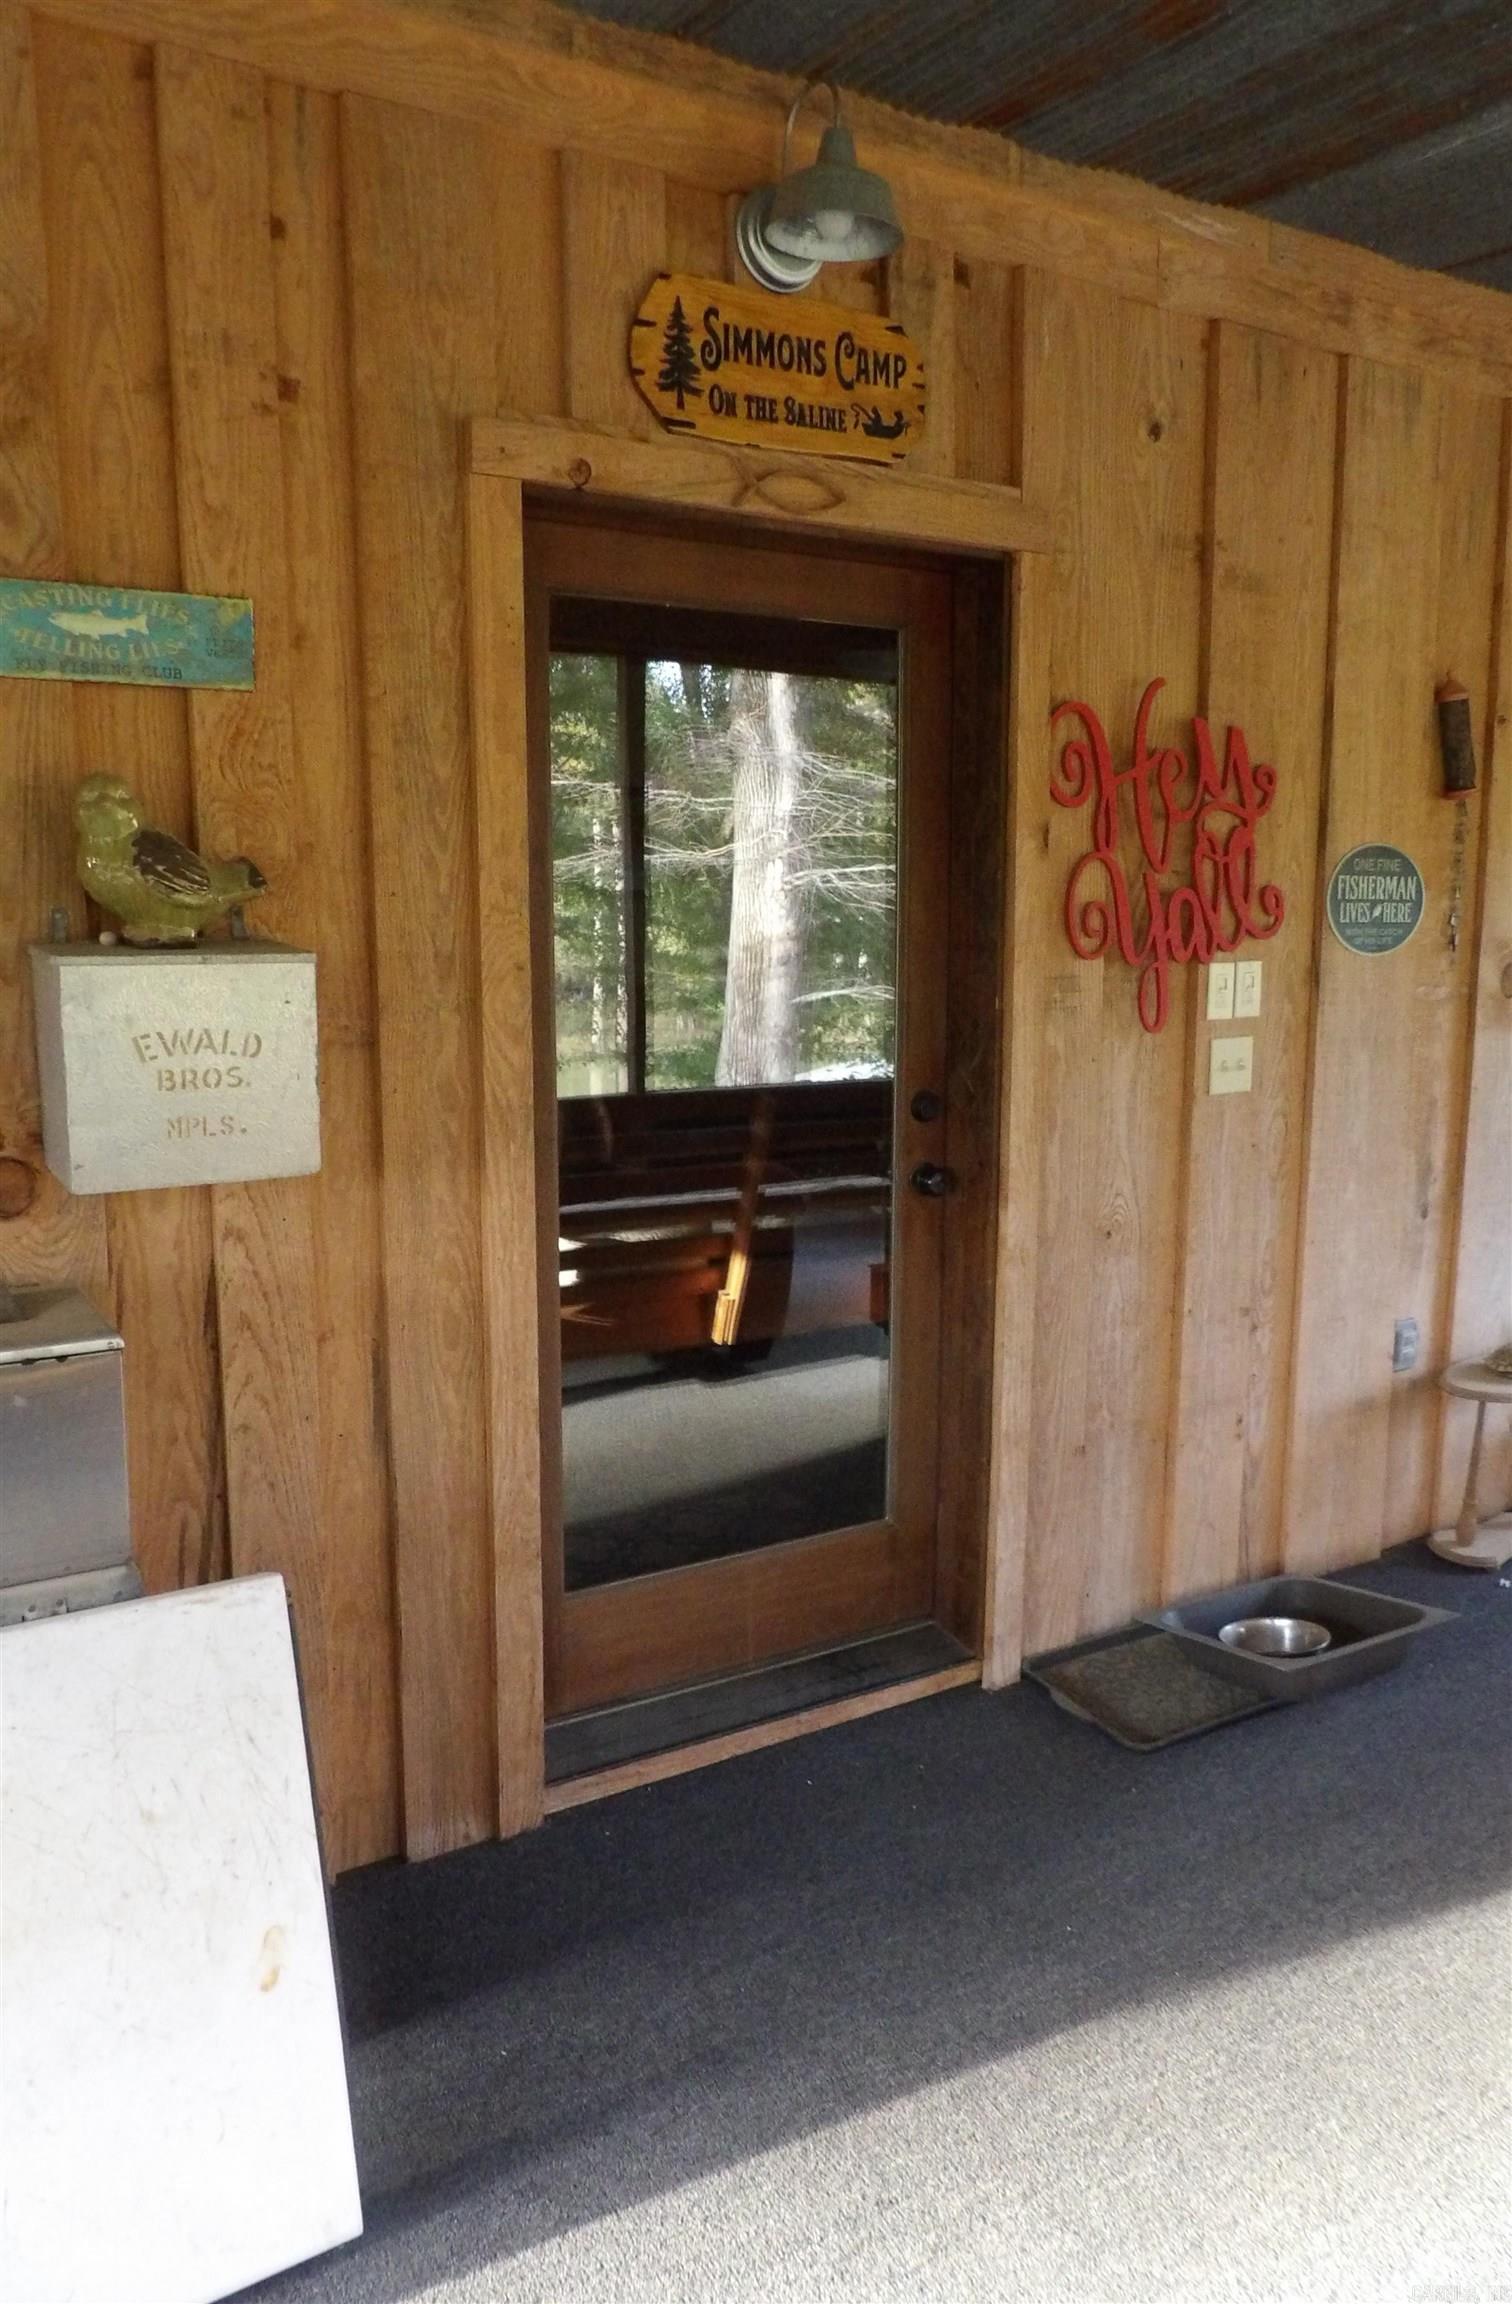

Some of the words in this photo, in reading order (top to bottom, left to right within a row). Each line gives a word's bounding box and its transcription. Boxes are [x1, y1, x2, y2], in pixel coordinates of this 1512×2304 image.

[700, 306, 828, 377] SIMMONS
[834, 331, 908, 391] CAMP
[708, 383, 737, 417] ON
[744, 392, 778, 424] THE
[783, 395, 848, 433] SALINE
[15, 628, 121, 661] TELLING
[141, 664, 184, 681] CLUB
[1337, 874, 1418, 900] FISHERMAN
[1339, 902, 1371, 924] LIVES
[1382, 902, 1413, 924] HERE
[130, 1027, 263, 1063] EWALD
[157, 1065, 251, 1092] BROS.
[166, 1115, 248, 1139] MPLS.
